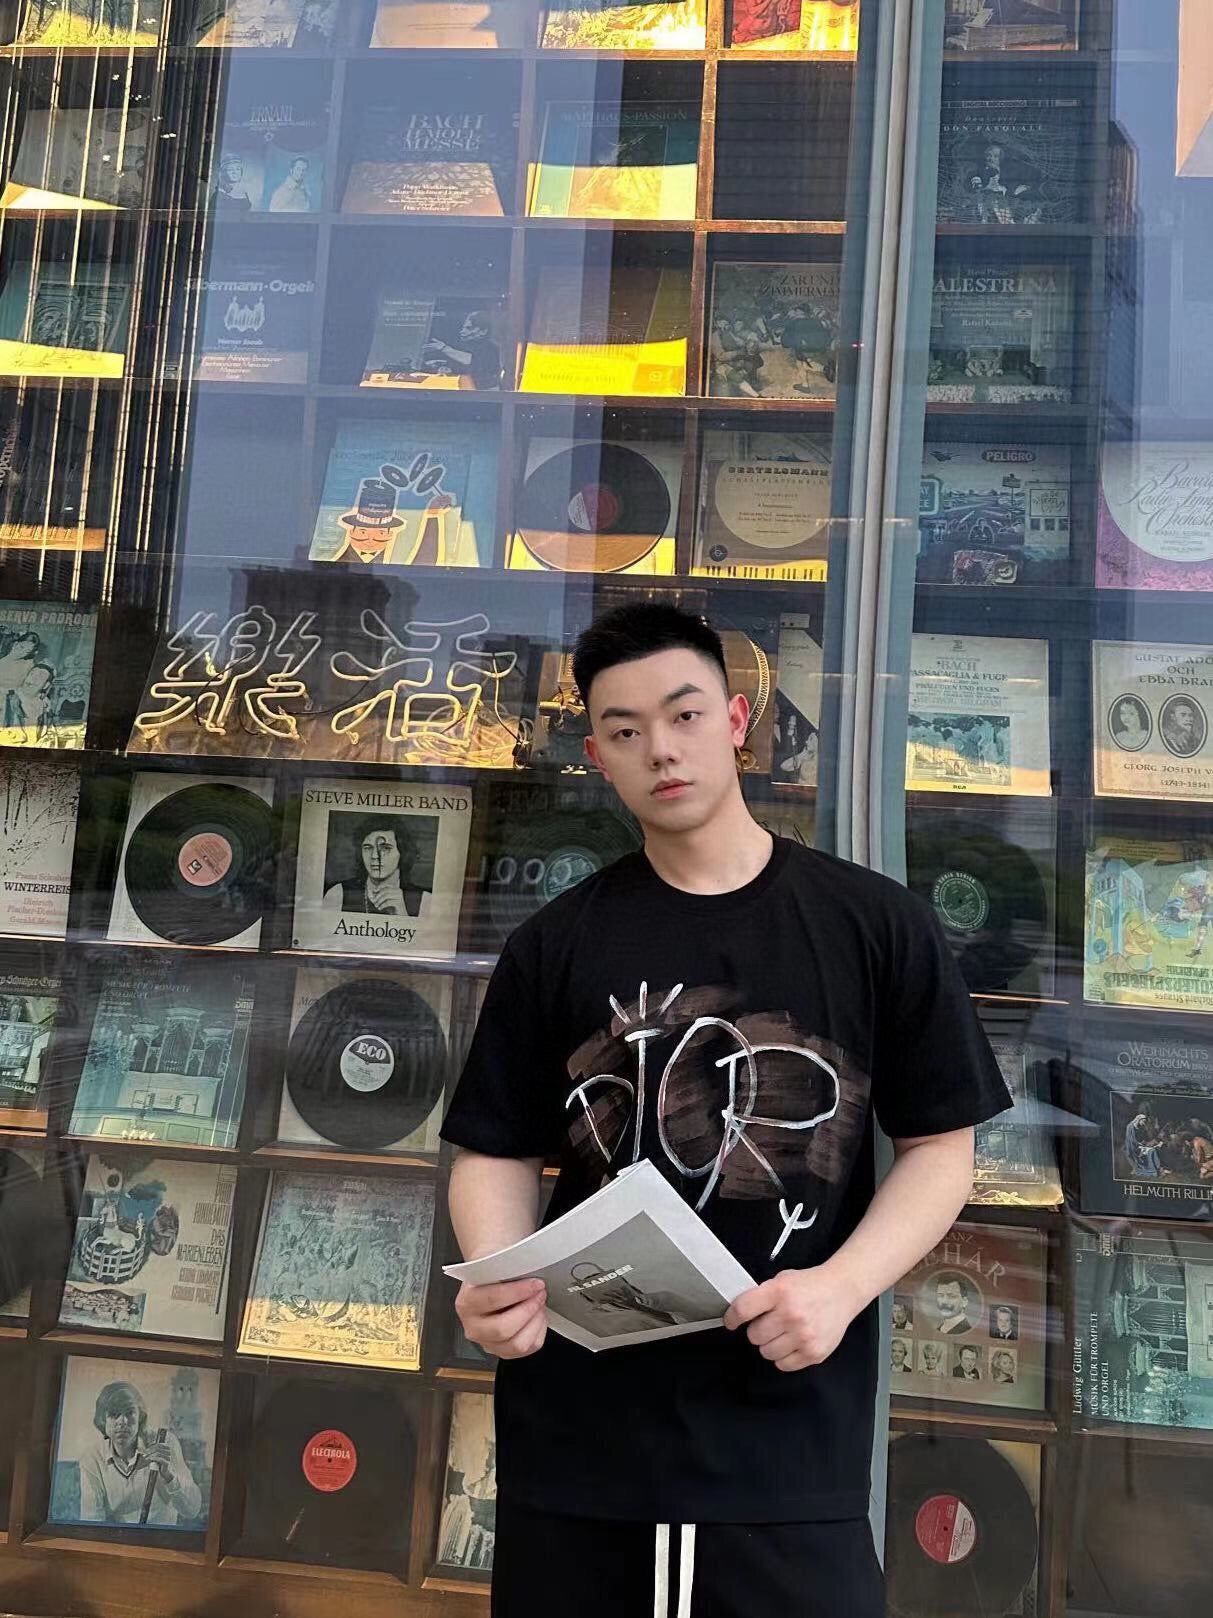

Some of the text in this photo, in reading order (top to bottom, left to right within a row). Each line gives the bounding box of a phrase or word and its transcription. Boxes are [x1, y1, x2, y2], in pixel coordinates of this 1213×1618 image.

[933, 276, 1057, 293] ALESTRINA
[985, 451, 1033, 462] PELIGRO
[1166, 665, 1196, 675] OCH
[305, 789, 468, 812] STEVE MILLER BAND
[333, 918, 417, 943] Anthology
[356, 1041, 387, 1061] ECO
[1128, 1040, 1209, 1060] WEIHNACHTS
[1117, 1051, 1191, 1070] ORATORIUM
[1124, 1184, 1213, 1201] HELMUTH RILLI
[944, 1231, 974, 1243] ANZ
[922, 1242, 1007, 1288] EHÁR
[1072, 1376, 1084, 1415] Ludwig
[312, 1447, 351, 1460] ELECTROLA
